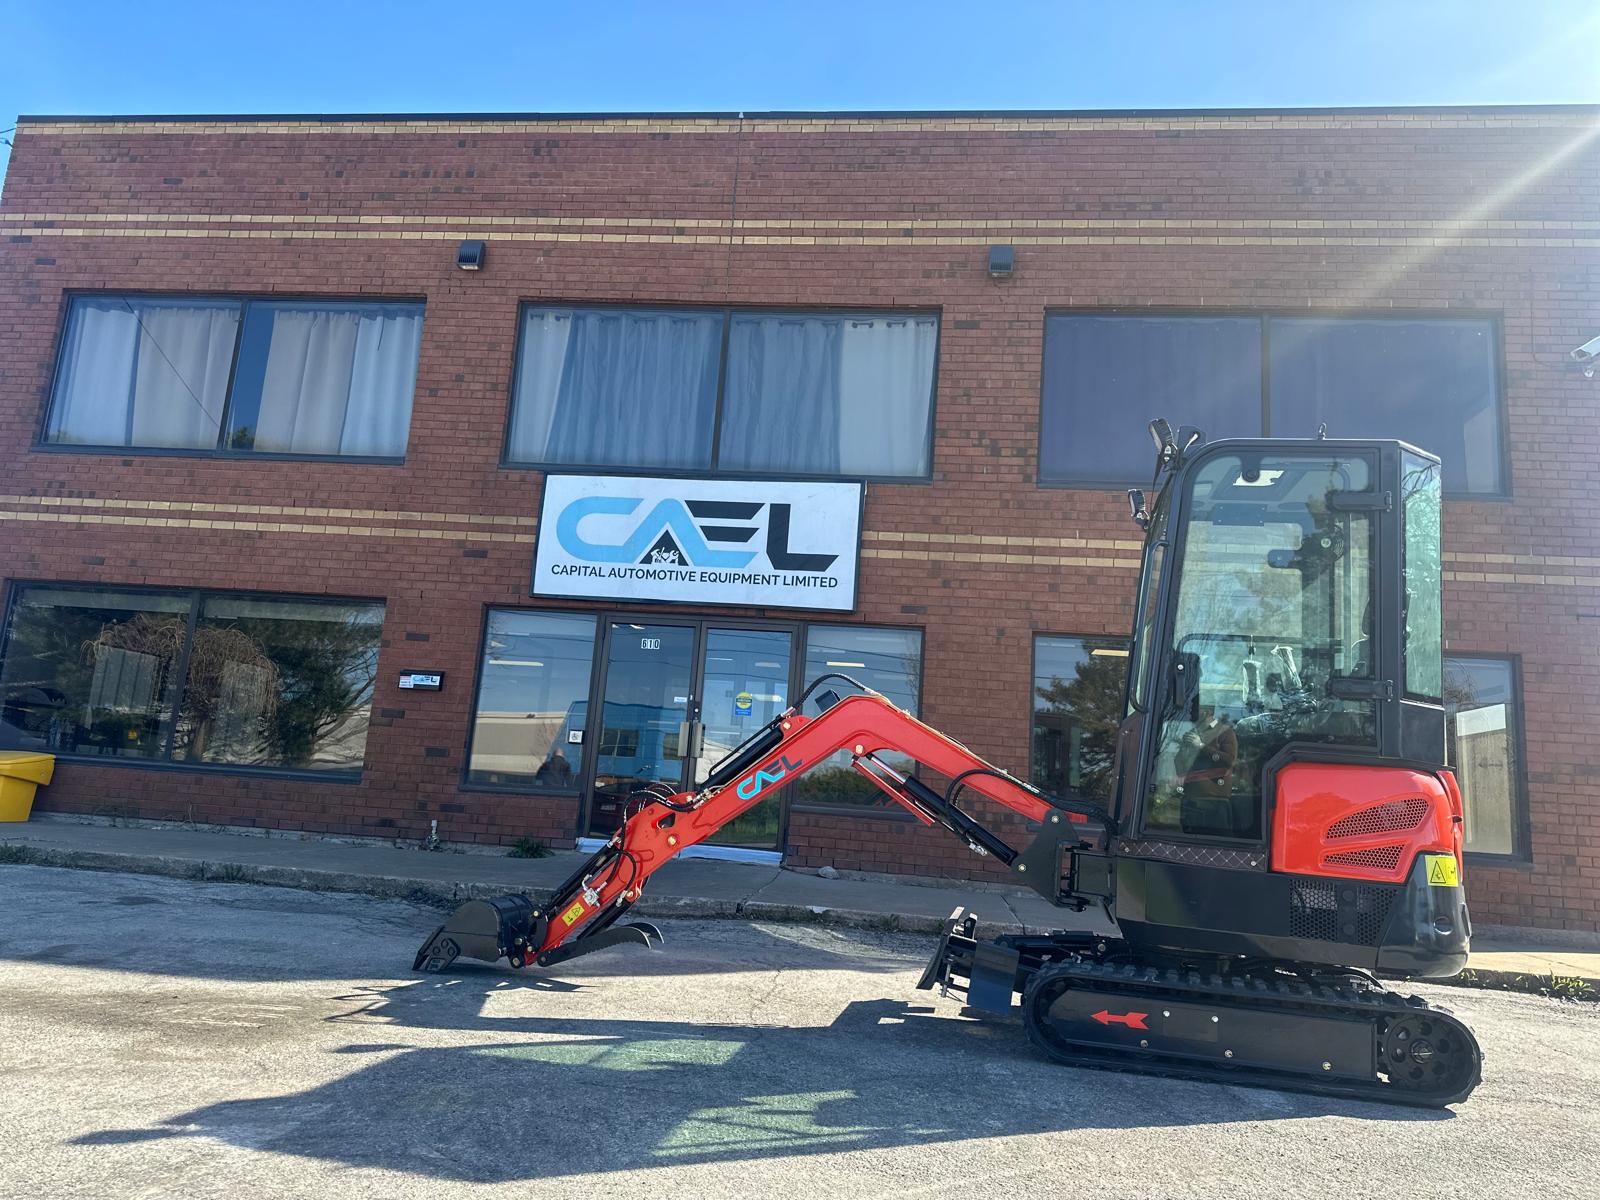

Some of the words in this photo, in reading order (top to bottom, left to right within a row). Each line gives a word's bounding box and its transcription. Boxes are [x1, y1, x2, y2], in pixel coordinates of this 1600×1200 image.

[556, 496, 839, 572] CAEL
[551, 564, 606, 578] CAPITAL
[608, 567, 697, 582] AUTOMOTIVE
[699, 571, 781, 586] EQUIPMENT
[783, 575, 839, 588] LIMITED
[642, 639, 659, 649] 610
[736, 755, 803, 800] CAEL
